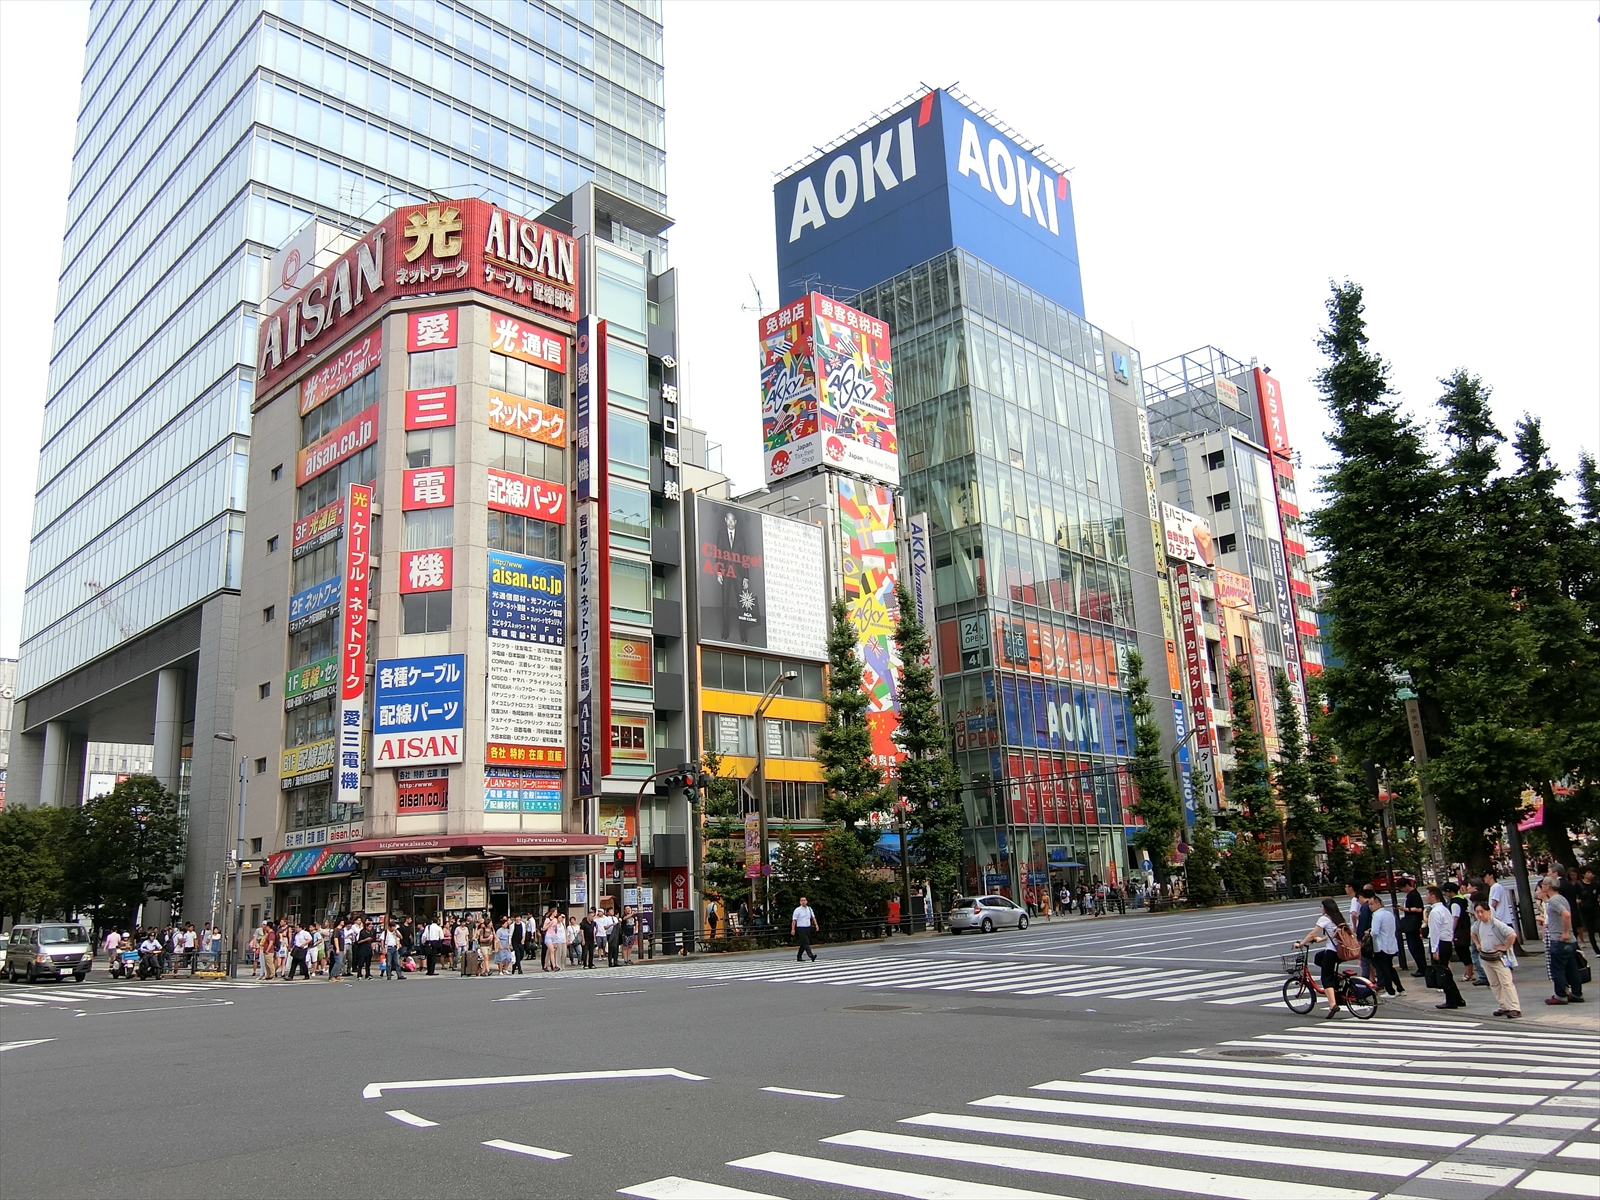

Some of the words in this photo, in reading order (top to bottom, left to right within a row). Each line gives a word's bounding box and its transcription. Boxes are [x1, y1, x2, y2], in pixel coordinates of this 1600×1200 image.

[789, 117, 917, 243] AOKI
[957, 118, 1059, 237] AOKI
[403, 206, 463, 262] 光
[484, 208, 576, 286] AISAN
[396, 261, 469, 286] ネットワーク
[484, 264, 575, 312] ケーブル・配線部材
[258, 227, 386, 380] AISAN
[766, 302, 805, 335] 免税店
[820, 299, 883, 339] 愛客免税店
[416, 312, 451, 347] 愛
[491, 319, 562, 366] 光通信
[766, 369, 804, 412] AKKY
[784, 386, 812, 401] INTERNATIONAL
[829, 364, 873, 408] AKKY
[414, 391, 448, 423] 三
[488, 396, 565, 441] ネットワーク
[852, 397, 887, 414] INTERNATIONAL
[1265, 379, 1283, 448] カラオケ
[578, 362, 589, 483] 愛三電機
[305, 419, 372, 477] aisan.co.jp
[662, 383, 680, 501] 坂口電熱
[794, 449, 814, 461] Tax-free
[795, 440, 814, 452] Japan.
[981, 436, 993, 450] 7F
[801, 454, 814, 465] Shop
[848, 451, 864, 461] Japan.
[866, 455, 884, 468] Tax-free
[884, 462, 896, 472] Shop
[412, 471, 446, 504] 電
[487, 473, 562, 515] 配線パーツ
[1169, 507, 1192, 523] ハニトー
[1177, 523, 1182, 532] &
[295, 522, 308, 541] 3F
[1166, 529, 1195, 547] 曲数世界一
[701, 542, 763, 569] Change!
[911, 522, 927, 575] AKKY
[1168, 541, 1197, 557] カラオケ
[409, 552, 445, 589] 機
[492, 566, 562, 596] aisan.co.jp
[702, 560, 737, 579] AGA
[345, 491, 368, 689] 光・ケーブル・ネットワーク
[579, 514, 590, 692] 各種ケーブル・ネットワーク機器
[914, 566, 925, 630] INTERNATION
[291, 597, 304, 616] 2F
[965, 633, 984, 644] OPEN
[380, 662, 460, 689] 各種ケーブル
[1041, 652, 1101, 677] ンターネット
[288, 674, 299, 692] 1F
[379, 701, 459, 727] 配線パーツ
[1259, 676, 1272, 733] ラムタラ
[1048, 700, 1099, 744] AOKI
[340, 710, 360, 790] 愛三電機
[377, 735, 459, 761] AISAN
[490, 746, 506, 759] 各社
[509, 747, 525, 760] 特約
[529, 749, 544, 761] 在庫
[547, 750, 562, 762] 直販
[581, 703, 590, 786] AISAN
[957, 729, 999, 750] OPEN
[283, 752, 296, 772] B1F
[400, 771, 410, 780] 各社
[413, 770, 424, 779] 特約
[1200, 751, 1214, 805] ダーツバー
[1183, 771, 1195, 811] AOKI
[379, 840, 439, 849] http://www.aisan.co.jp
[675, 888, 684, 909] 坂口
